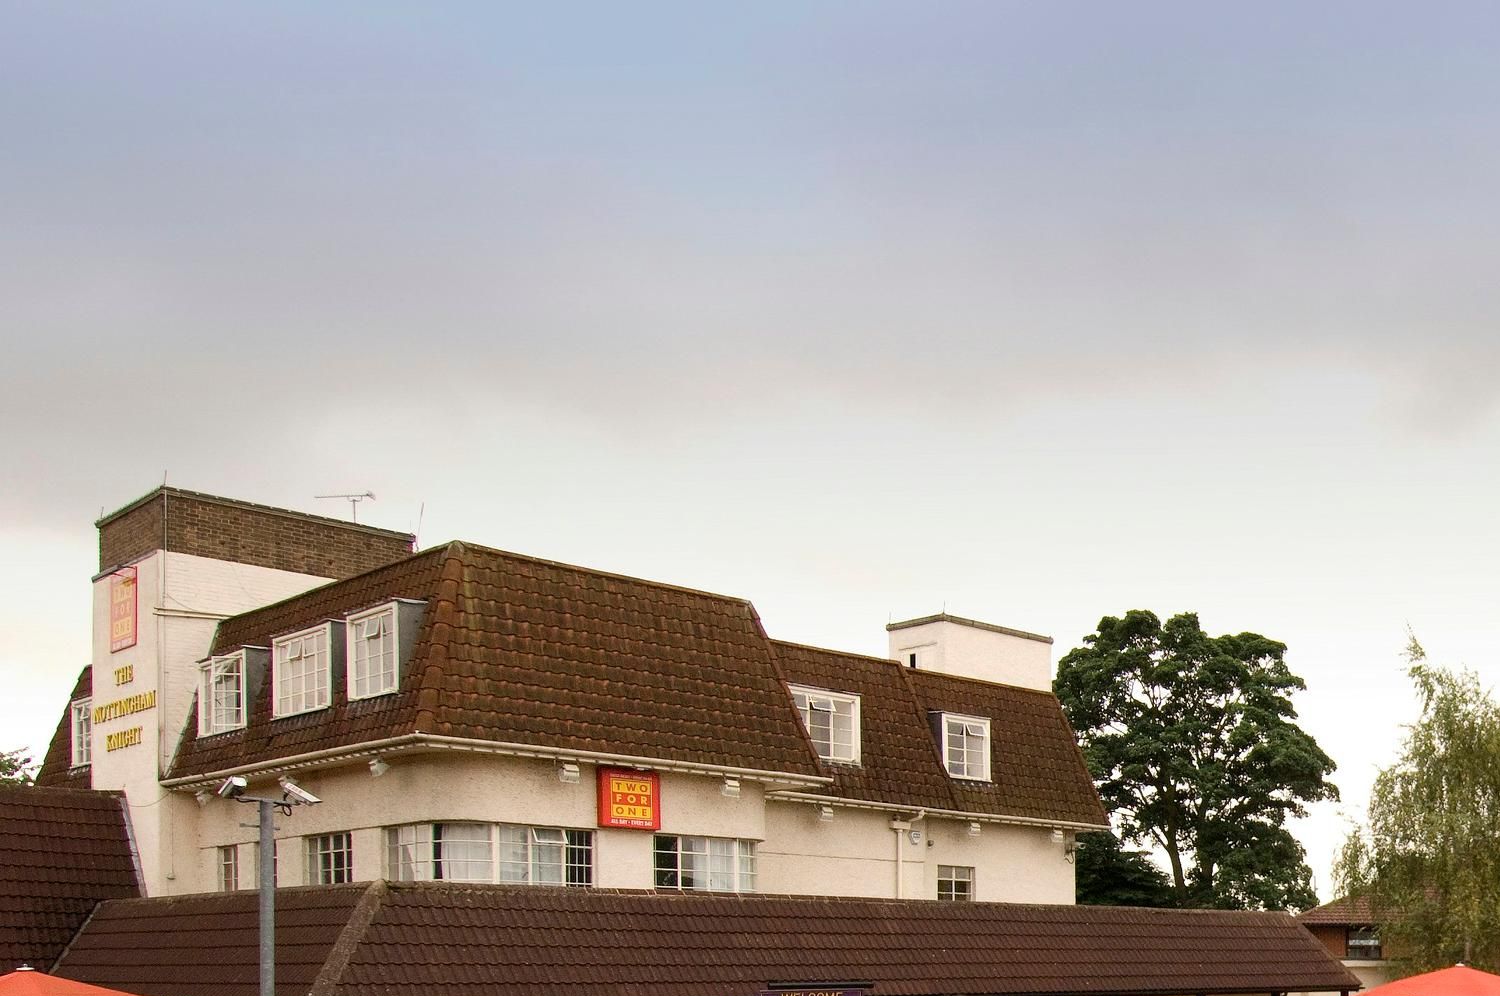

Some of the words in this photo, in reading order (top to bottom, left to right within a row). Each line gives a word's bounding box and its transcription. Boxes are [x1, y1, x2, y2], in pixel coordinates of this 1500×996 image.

[114, 664, 134, 686] THE
[93, 690, 157, 725] NOTTINGHAM
[106, 726, 143, 752] KNIGHT
[615, 782, 648, 793] TWO
[616, 793, 648, 806] FOR
[615, 806, 648, 817] ONE
